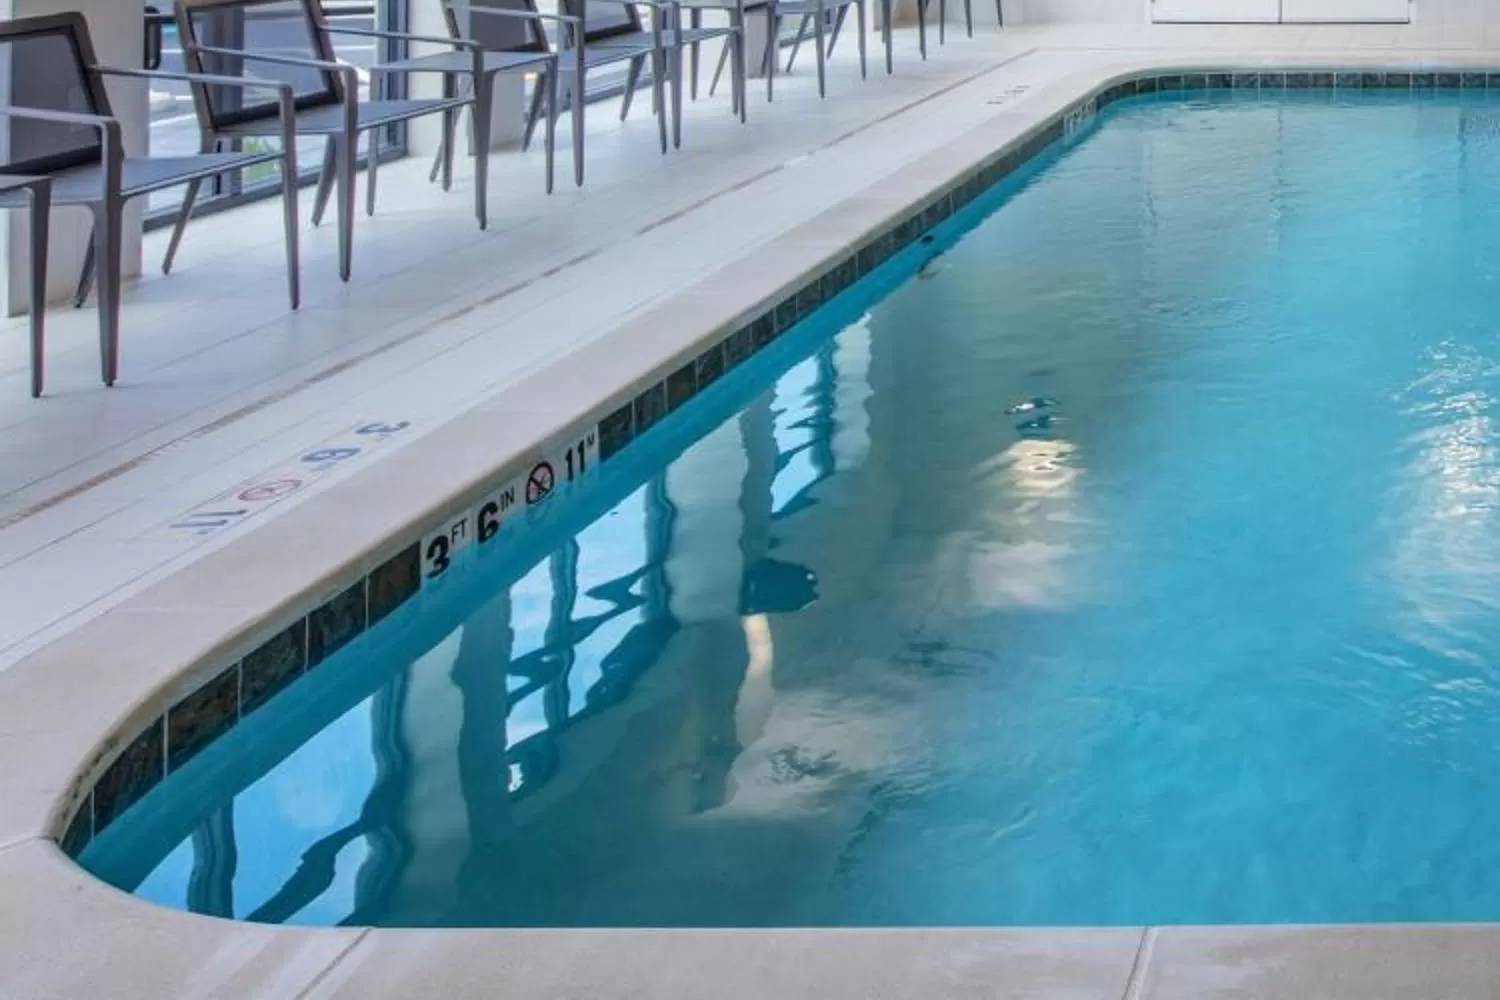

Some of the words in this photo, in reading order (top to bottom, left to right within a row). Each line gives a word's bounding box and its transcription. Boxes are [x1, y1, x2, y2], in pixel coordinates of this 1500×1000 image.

[426, 535, 450, 579] 3
[477, 502, 499, 544] 6
[565, 440, 585, 481] 11
